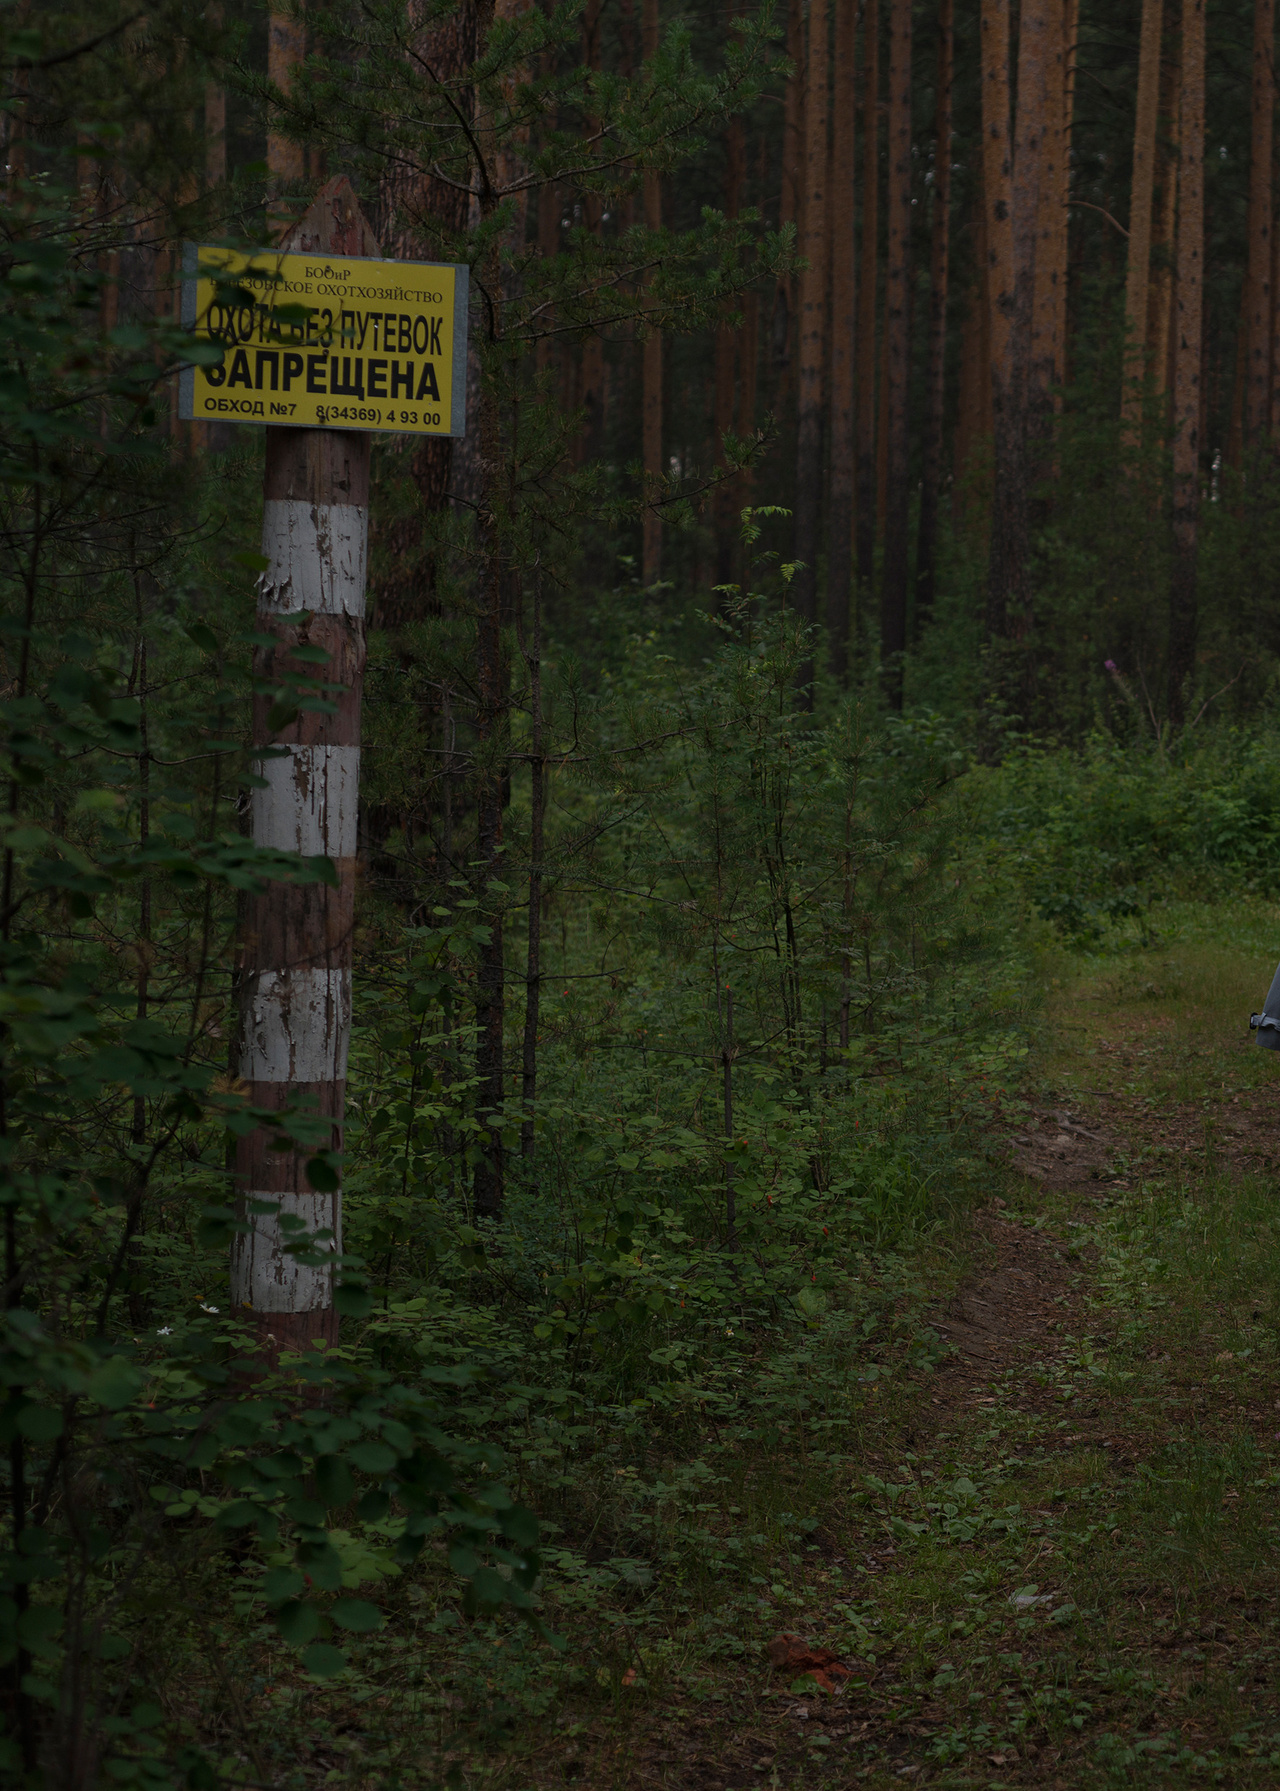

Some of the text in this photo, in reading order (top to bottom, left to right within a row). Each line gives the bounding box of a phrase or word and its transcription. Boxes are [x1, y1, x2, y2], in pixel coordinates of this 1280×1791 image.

[304, 265, 352, 282] БООиР
[317, 283, 443, 304] ОХОТХОЗЯЙСТВО
[207, 302, 283, 345] ОХОТА
[341, 310, 443, 356] ПУТЕВОК
[204, 397, 441, 426] ОБХОД №7 8(34369) 4 93 00
